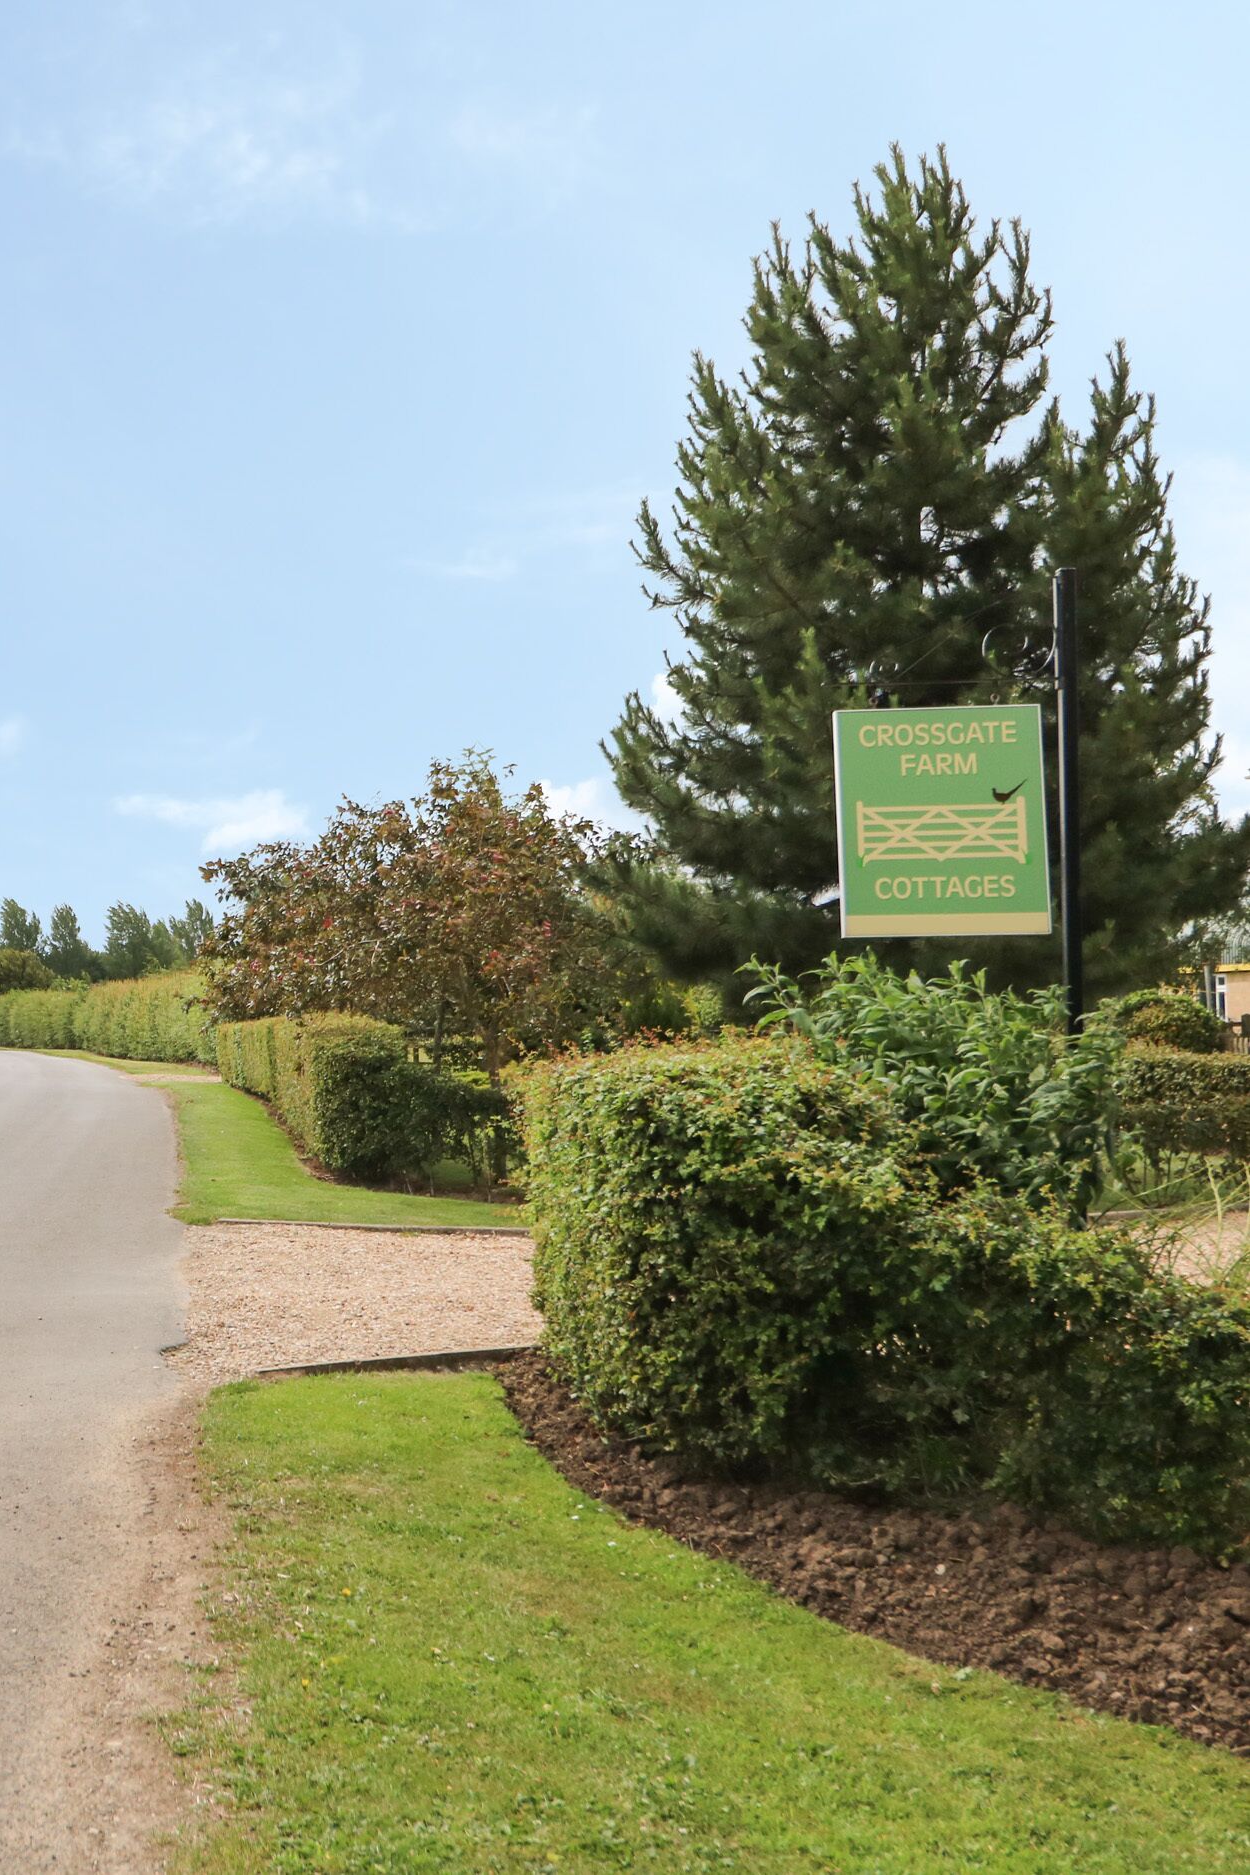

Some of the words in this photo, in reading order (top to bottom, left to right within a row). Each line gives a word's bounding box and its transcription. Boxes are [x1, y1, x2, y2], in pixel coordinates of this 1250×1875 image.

[858, 720, 1017, 748] CROSSGATE
[900, 752, 978, 777] FARM
[874, 875, 1016, 900] COTTAGES
